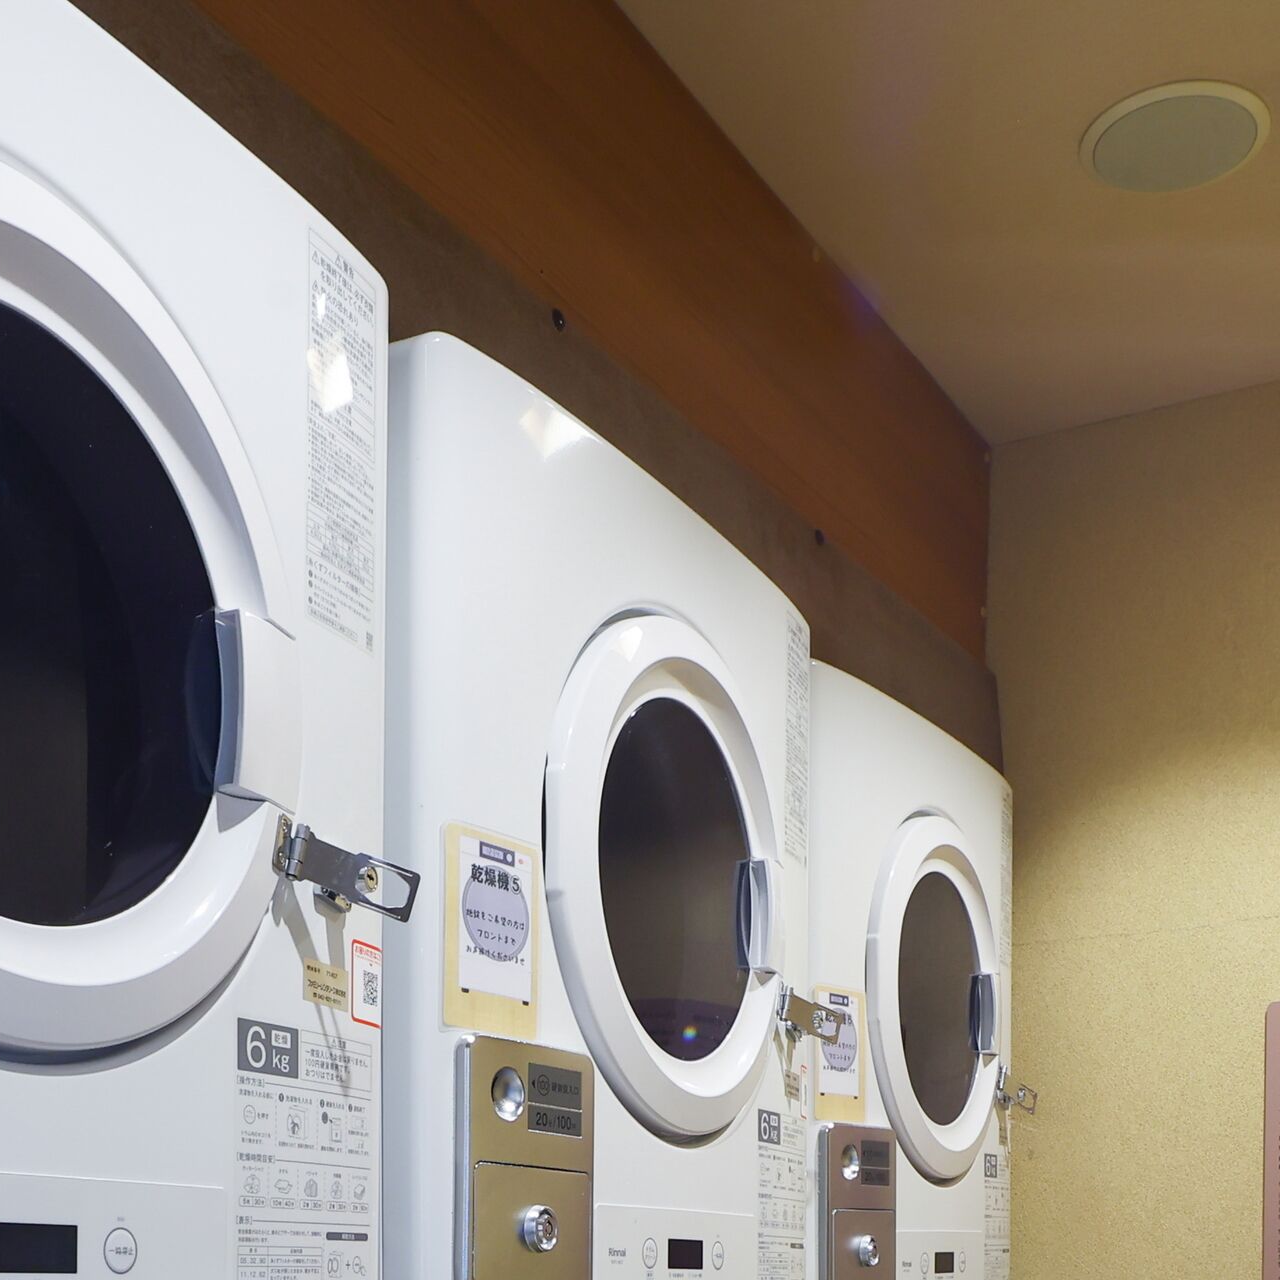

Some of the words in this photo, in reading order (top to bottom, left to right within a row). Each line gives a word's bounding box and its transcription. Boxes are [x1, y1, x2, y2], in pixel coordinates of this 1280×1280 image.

[246, 1026, 266, 1068] 6
[272, 1049, 290, 1073] kg
[761, 1113, 770, 1140] 6
